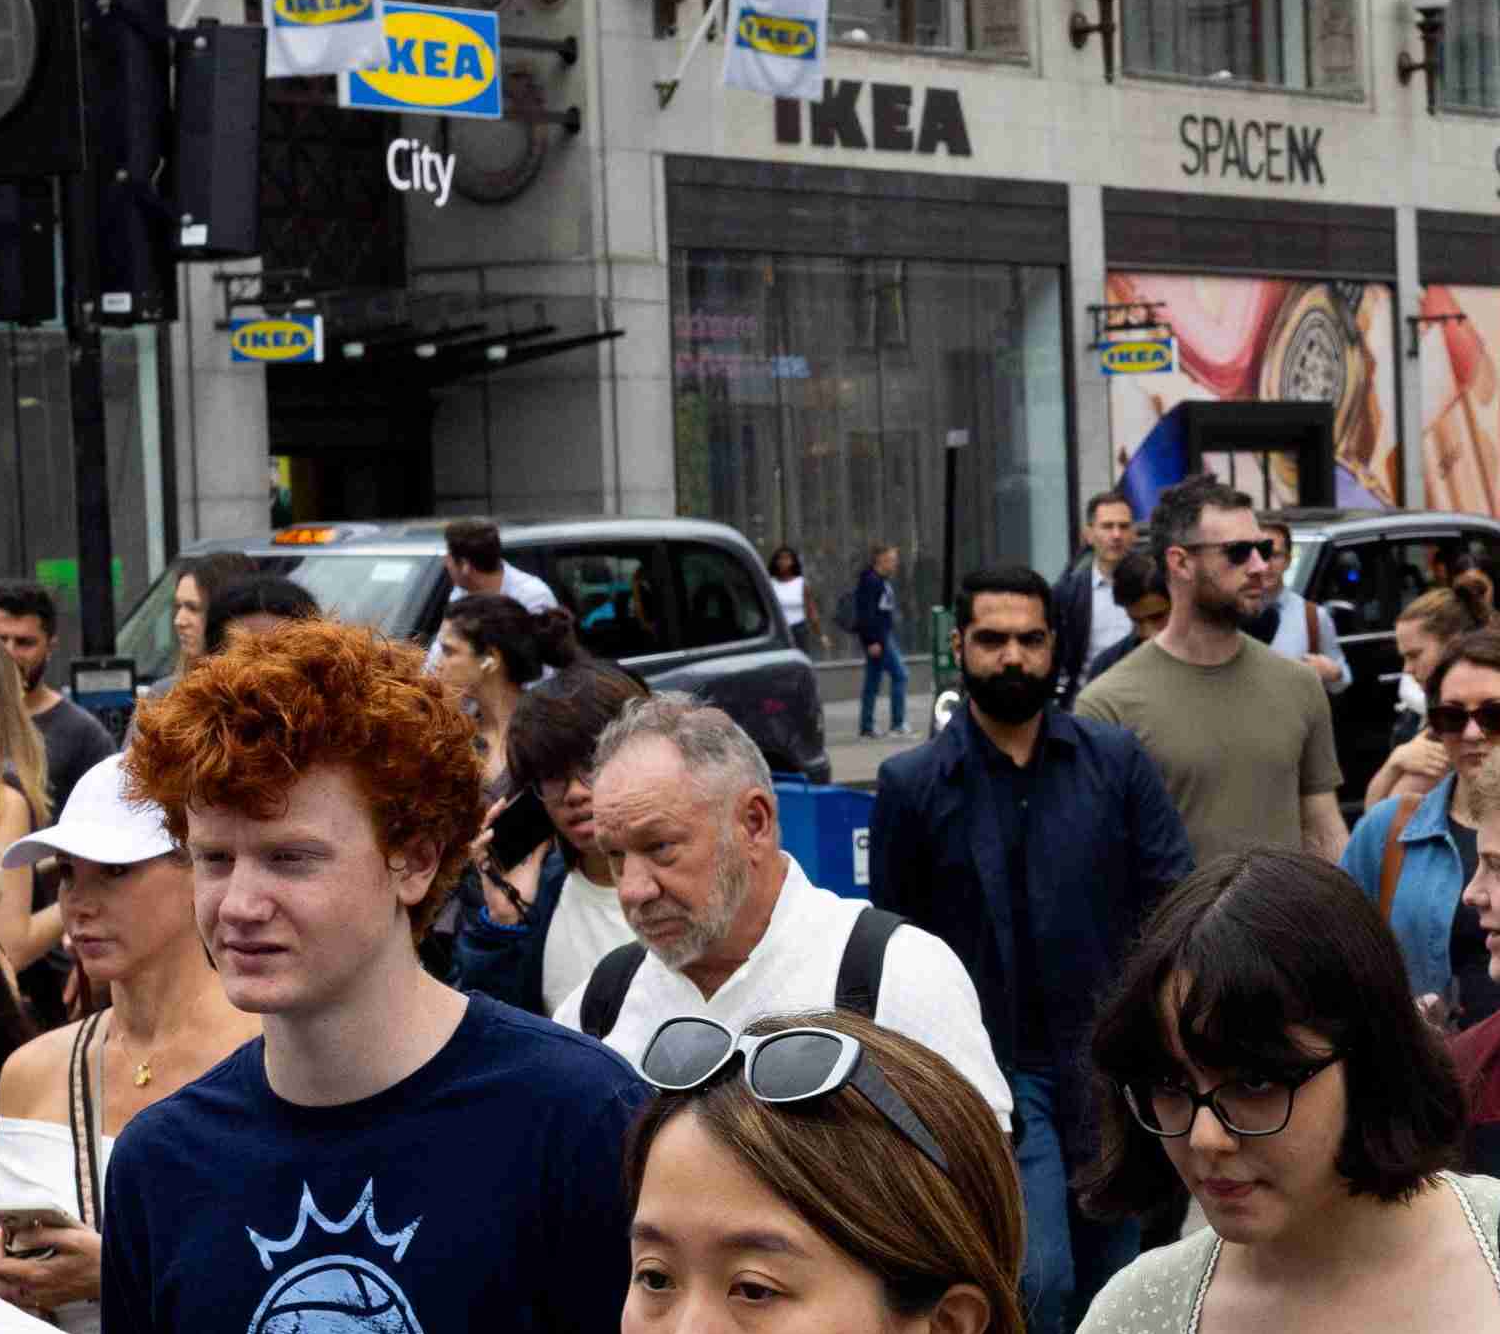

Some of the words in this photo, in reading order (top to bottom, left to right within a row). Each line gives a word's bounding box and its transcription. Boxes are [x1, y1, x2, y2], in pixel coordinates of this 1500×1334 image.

[745, 20, 810, 44] IKEA
[365, 36, 485, 83] KEA
[774, 77, 973, 158] IKEA
[386, 137, 455, 207] City
[240, 330, 307, 348] IKEA
[1108, 351, 1164, 364] IKEA
